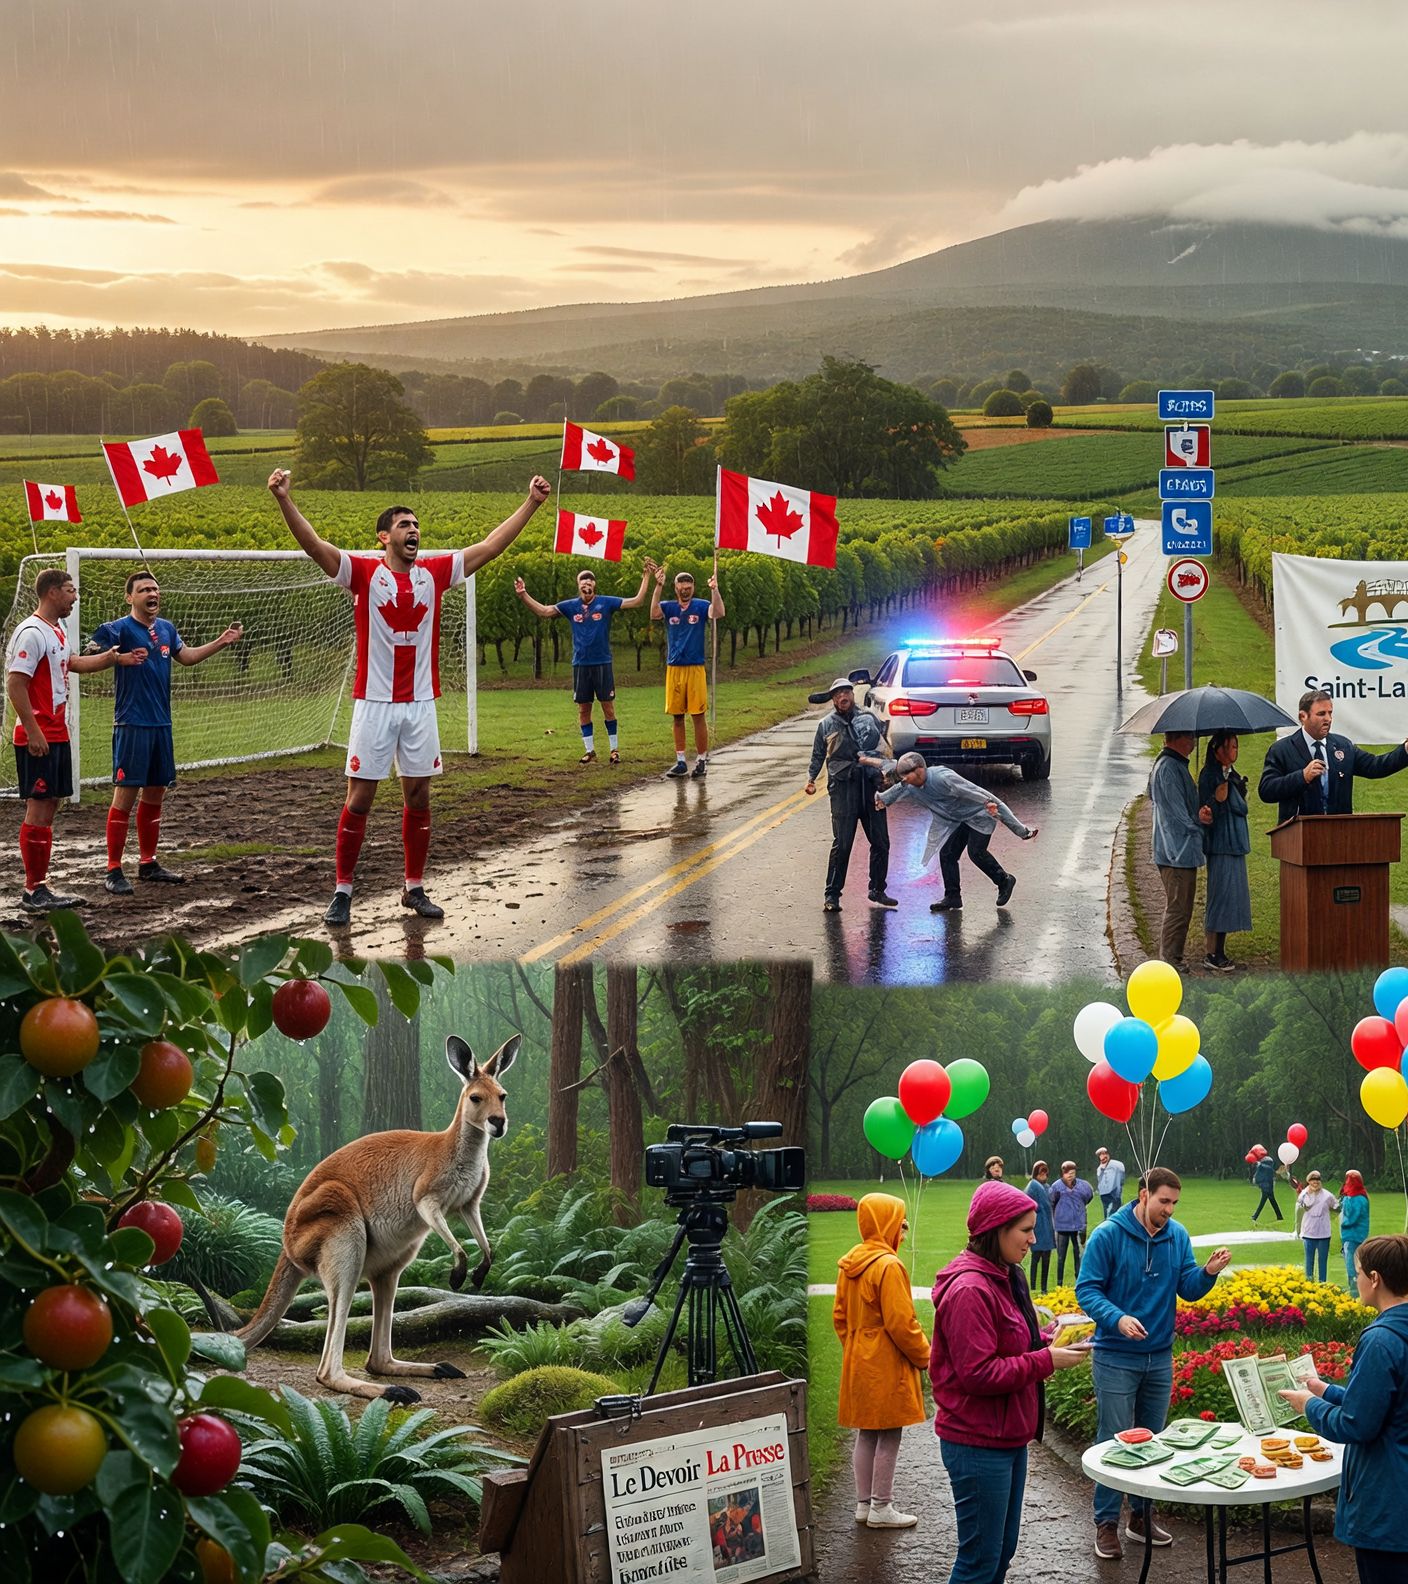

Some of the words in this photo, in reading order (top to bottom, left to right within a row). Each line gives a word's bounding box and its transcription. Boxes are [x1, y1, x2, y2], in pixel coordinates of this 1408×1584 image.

[610, 1473, 638, 1498] Le
[639, 1458, 701, 1492] Devoir
[706, 1450, 731, 1476] La
